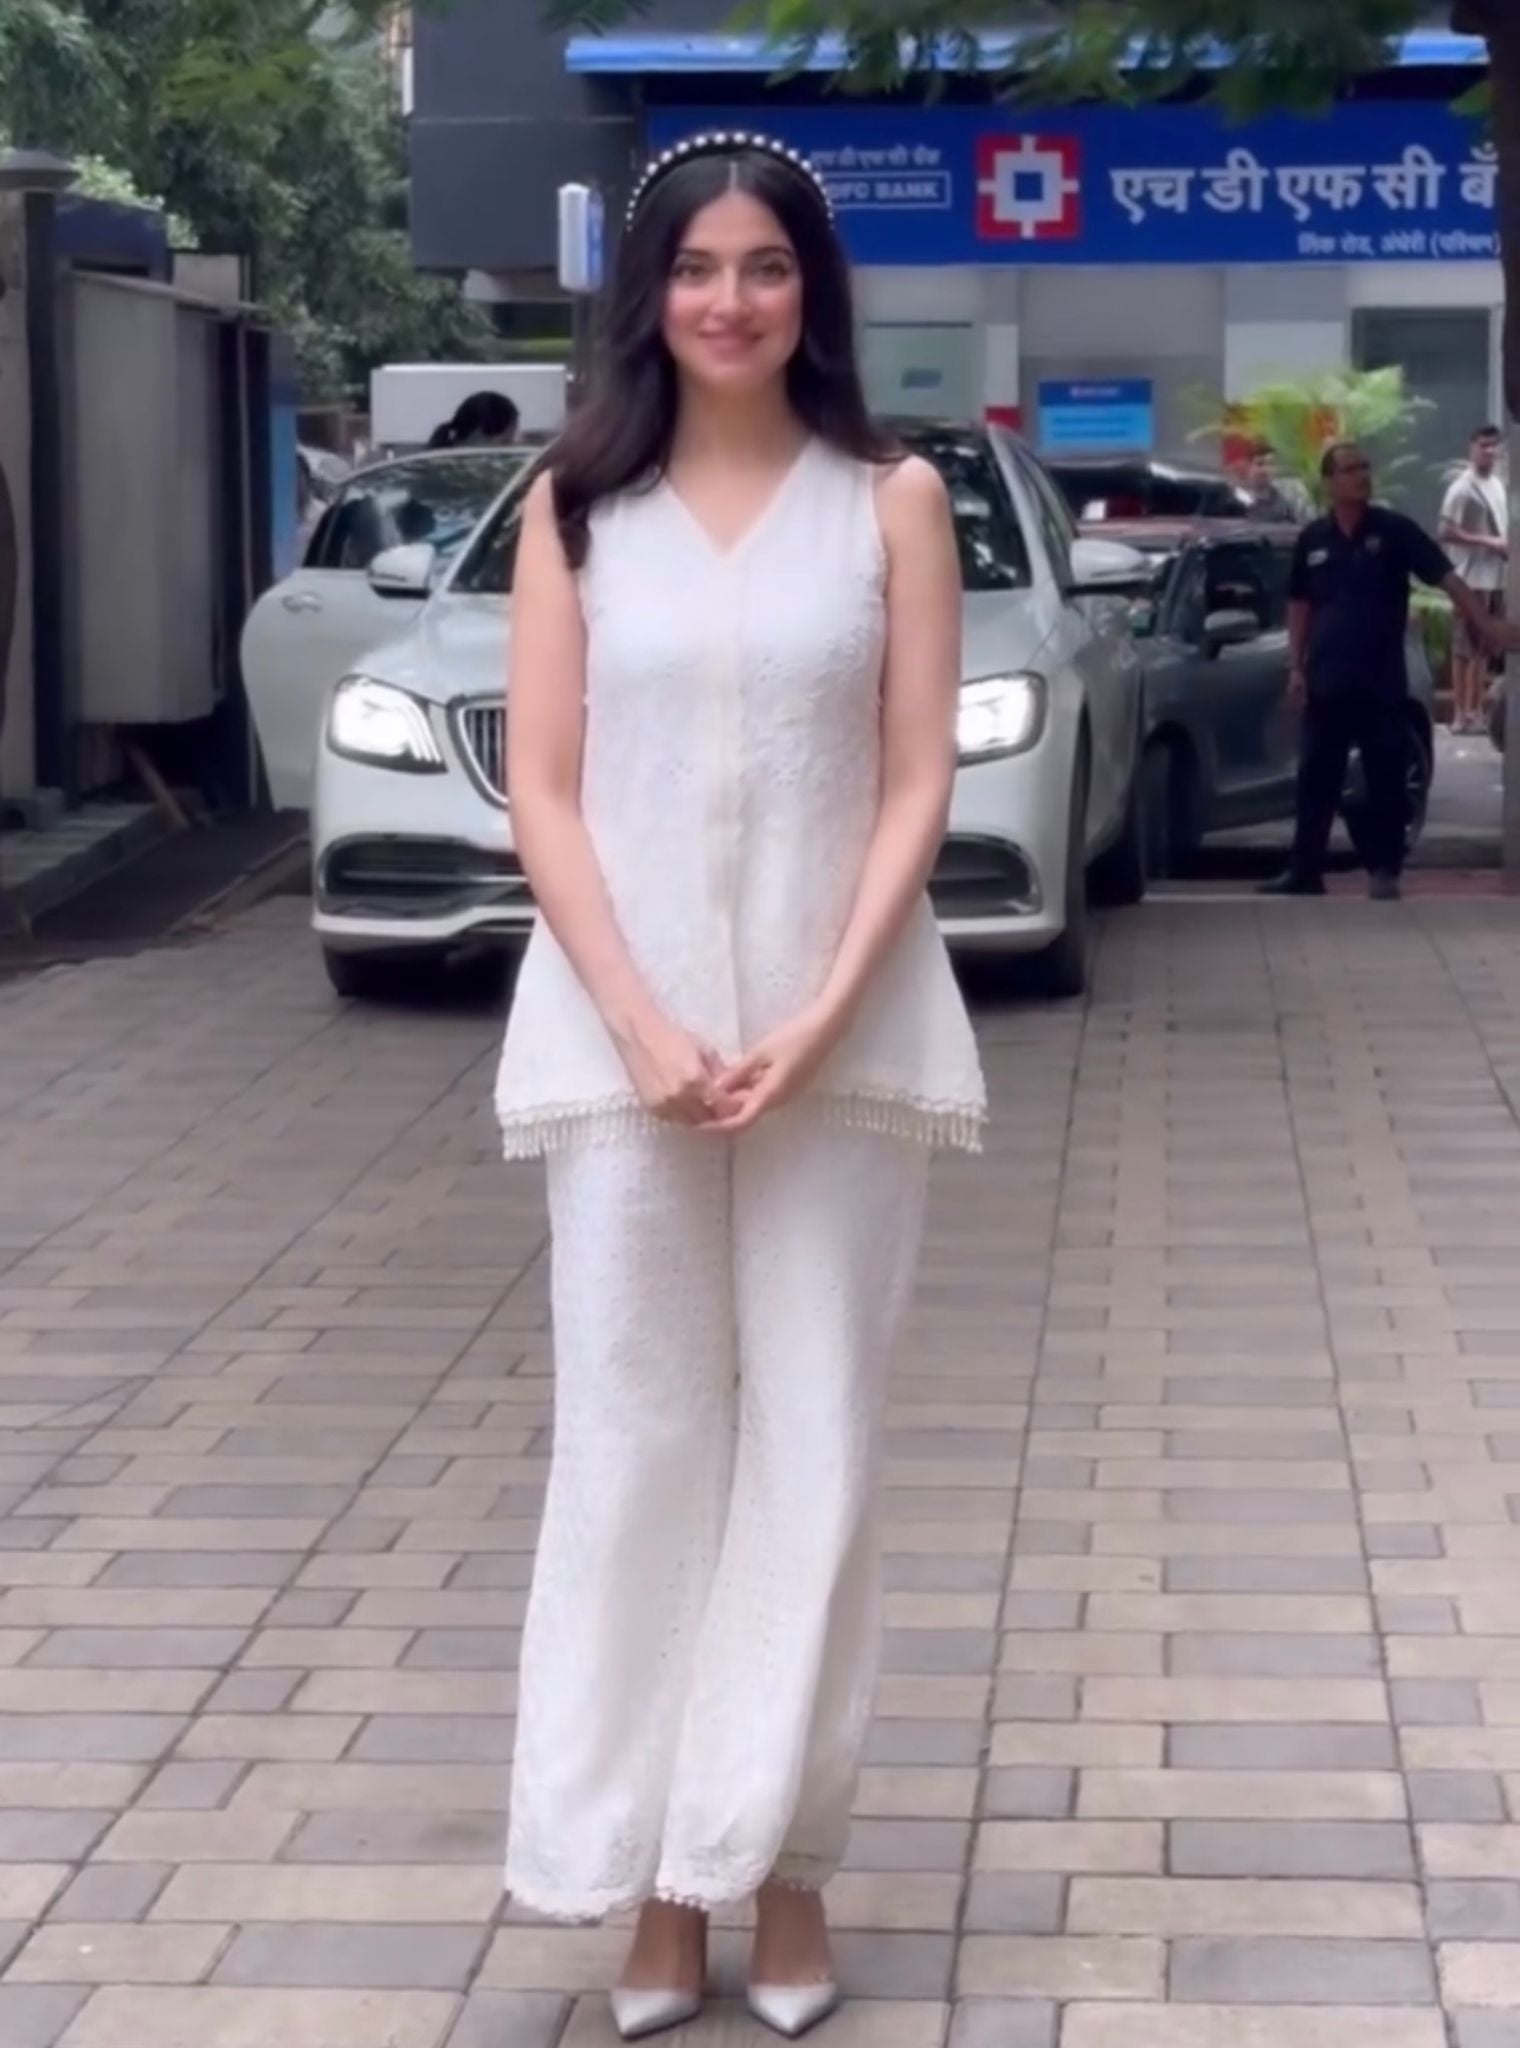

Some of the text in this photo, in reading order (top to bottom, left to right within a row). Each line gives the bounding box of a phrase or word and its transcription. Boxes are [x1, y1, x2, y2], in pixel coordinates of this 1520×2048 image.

[875, 181, 938, 199] BANK
[1110, 168, 1195, 224] एच
[1200, 147, 1270, 213] डी
[1274, 165, 1366, 222] एफ
[1371, 144, 1446, 210] सी
